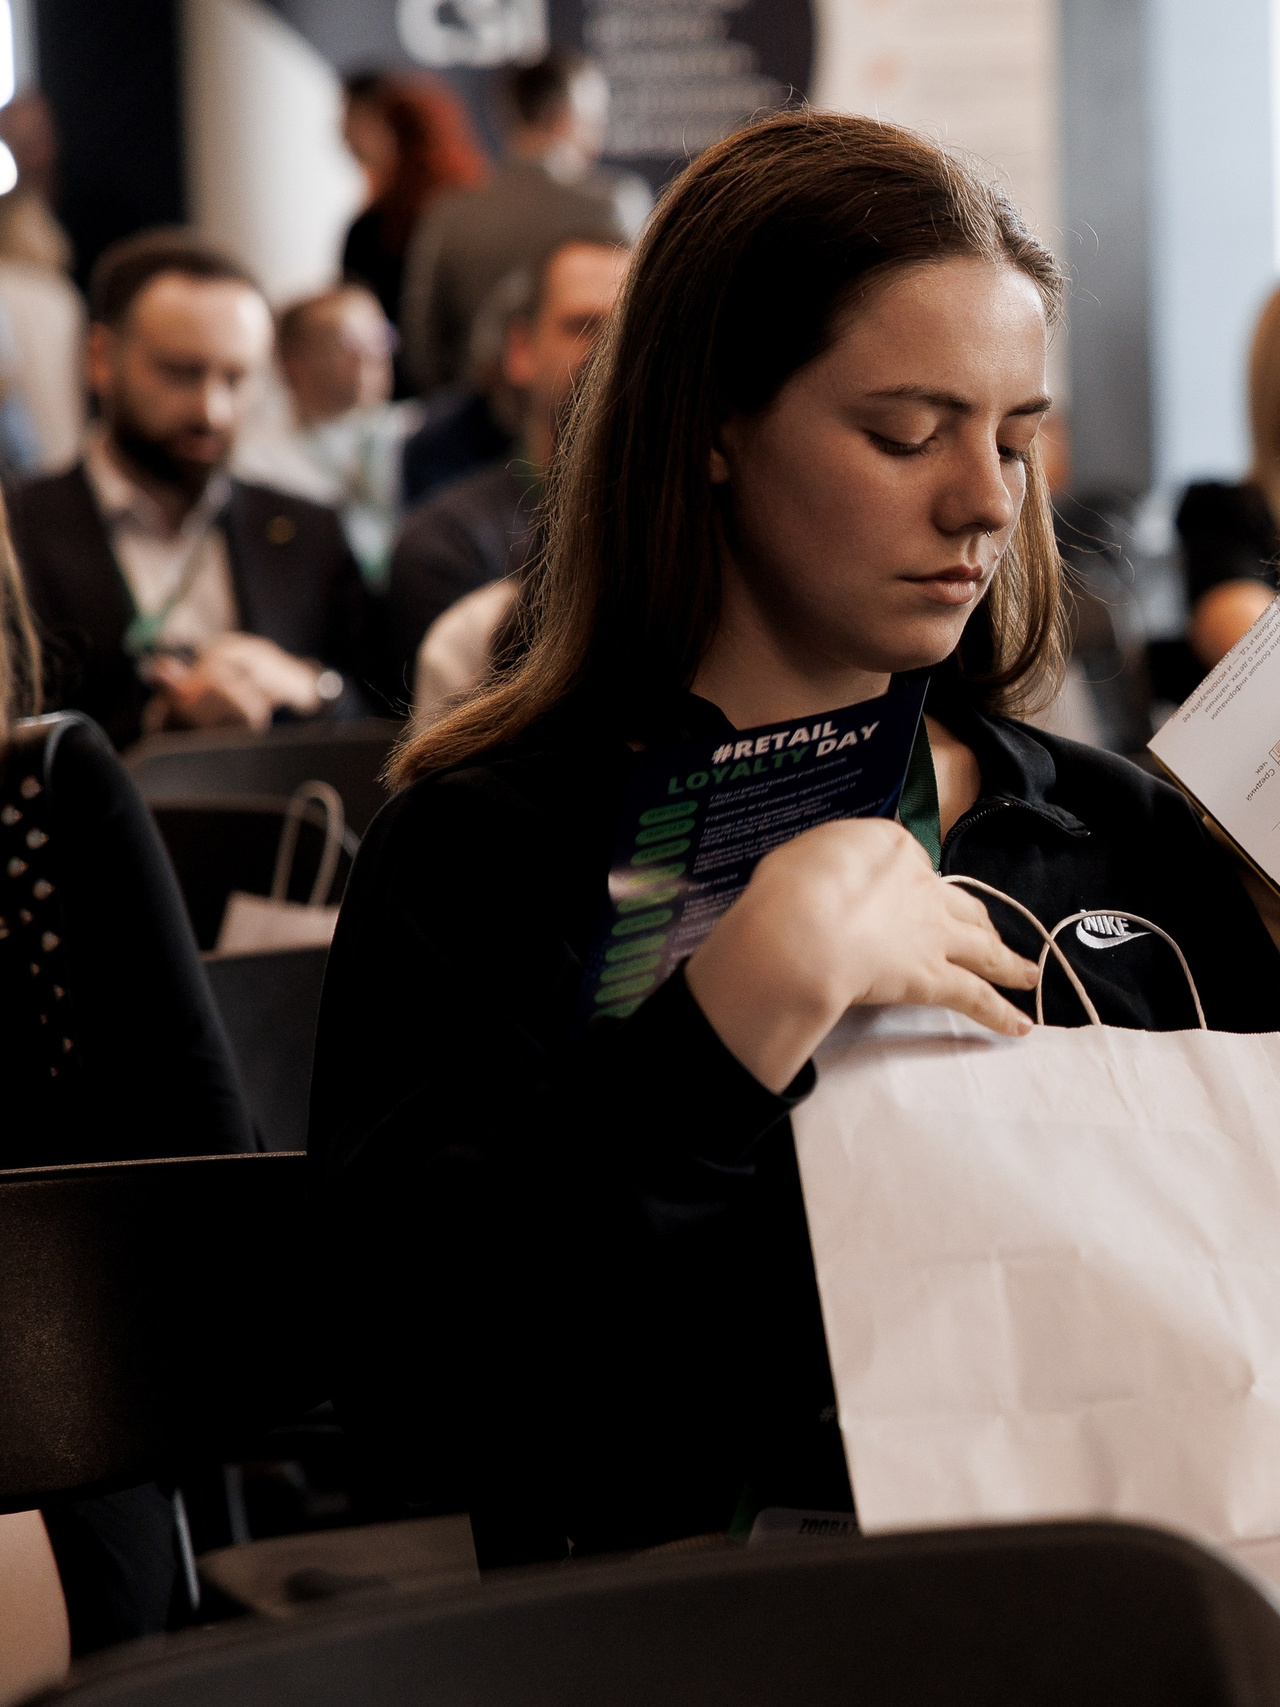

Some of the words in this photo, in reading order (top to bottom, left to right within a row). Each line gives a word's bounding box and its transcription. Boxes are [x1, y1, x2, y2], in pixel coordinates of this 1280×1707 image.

[1247, 650, 1271, 676] больше
[1190, 670, 1227, 713] используйте
[1203, 683, 1229, 713] наличии
[1210, 676, 1248, 720] информации
[1181, 712, 1191, 722] ее
[667, 745, 809, 795] LOYALTY
[815, 720, 880, 757] DAY
[711, 720, 838, 764] #RETAIL
[1254, 761, 1268, 774] чек
[1245, 768, 1275, 801] Средний
[1080, 909, 1129, 936] NIKE
